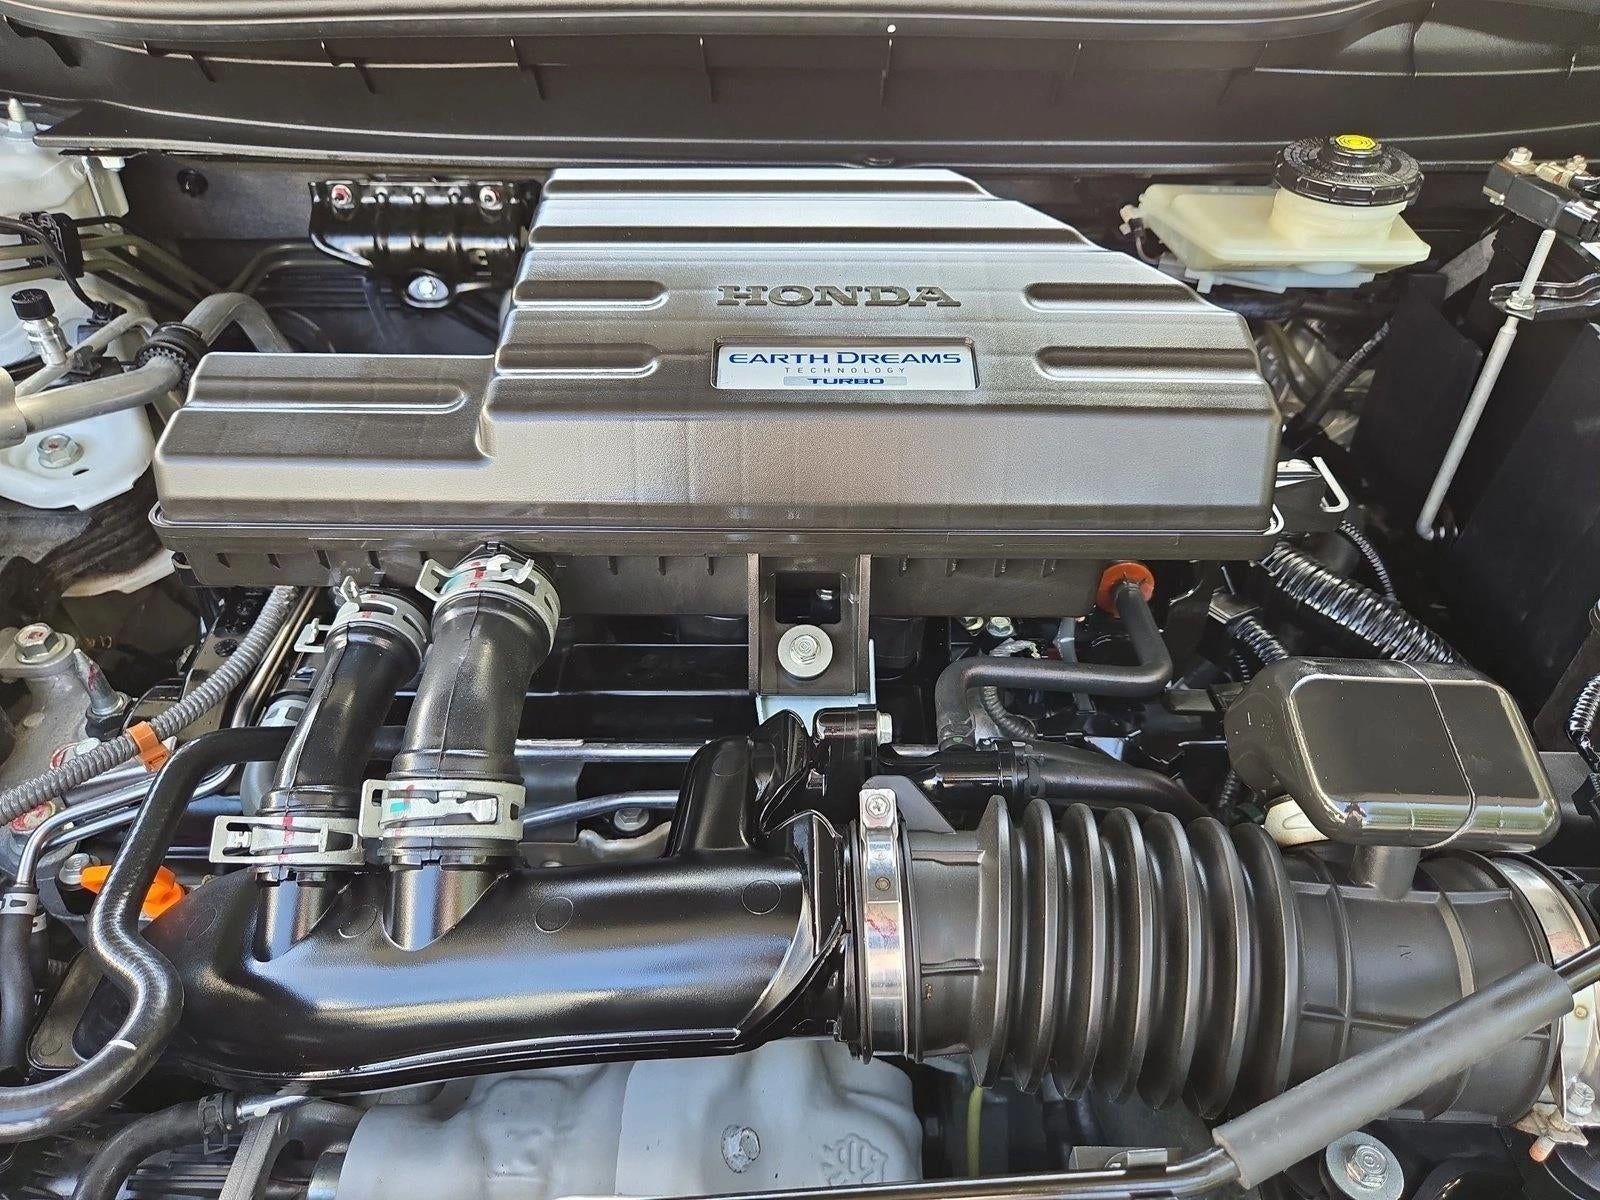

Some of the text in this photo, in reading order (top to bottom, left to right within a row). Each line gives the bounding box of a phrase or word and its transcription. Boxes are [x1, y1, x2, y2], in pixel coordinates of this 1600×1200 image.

[716, 285, 962, 307] HONDA
[728, 353, 830, 364] EARTH
[784, 367, 906, 375] TECHNOLOGY
[807, 378, 885, 386] TURBO
